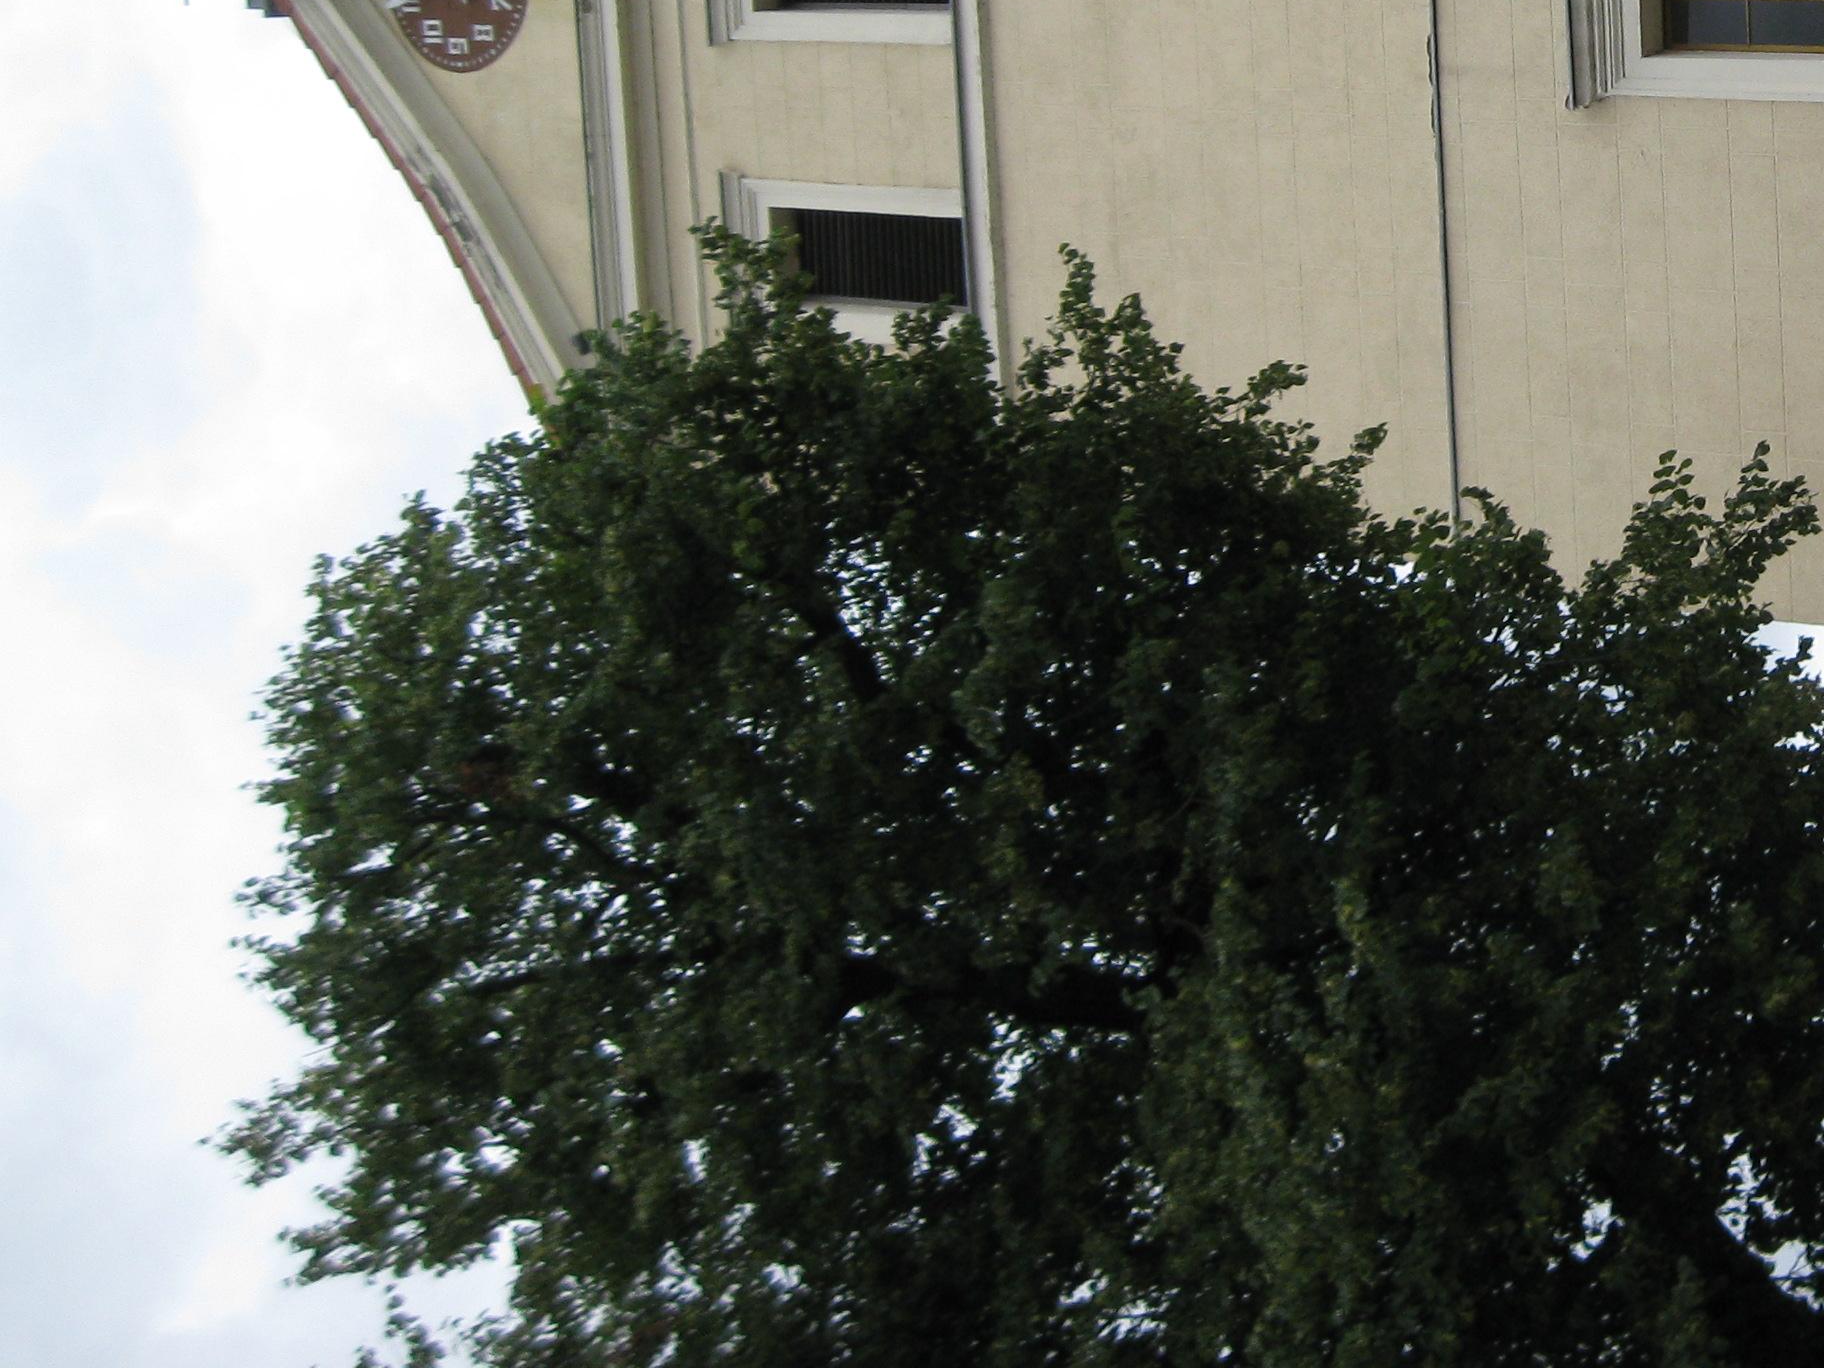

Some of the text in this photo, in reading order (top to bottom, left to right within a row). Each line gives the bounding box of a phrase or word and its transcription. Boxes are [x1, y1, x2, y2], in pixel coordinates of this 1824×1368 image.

[422, 20, 442, 44] 10
[471, 24, 494, 41] 8
[447, 38, 470, 54] 9
